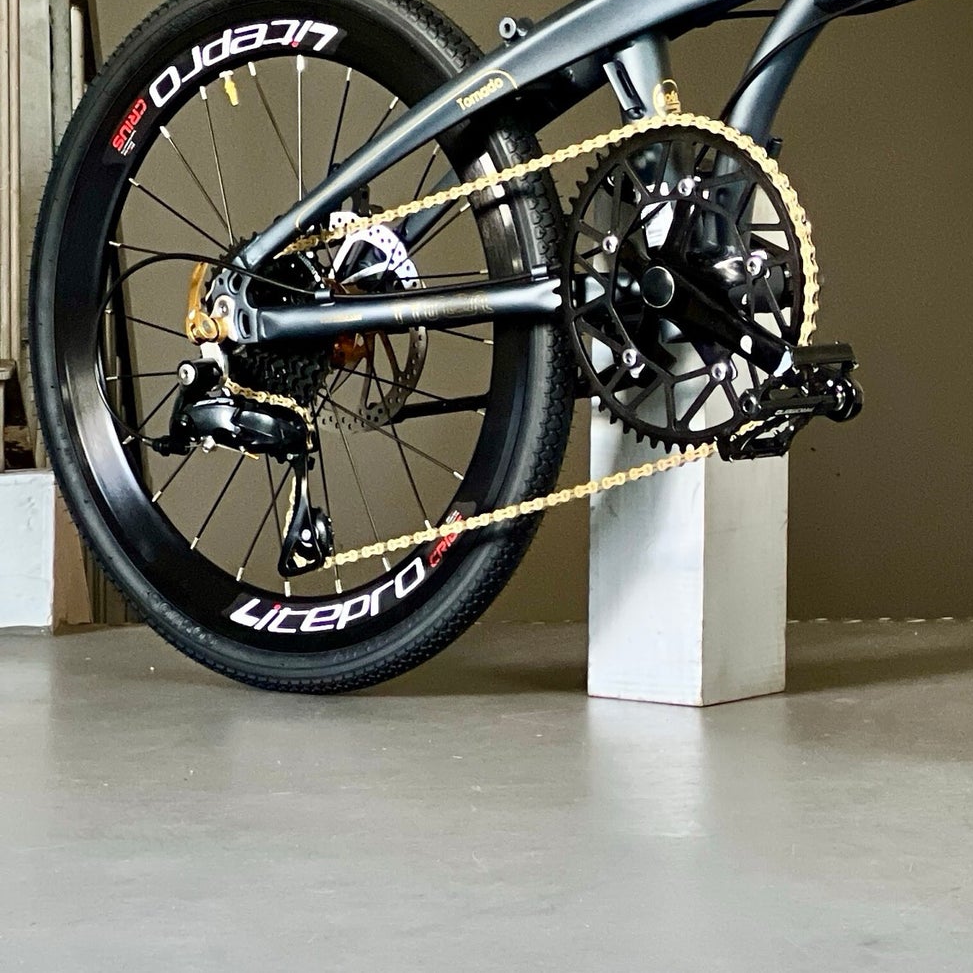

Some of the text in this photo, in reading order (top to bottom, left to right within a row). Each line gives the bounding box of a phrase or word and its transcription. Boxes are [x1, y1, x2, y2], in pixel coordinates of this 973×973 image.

[149, 19, 339, 108] Litepro
[111, 97, 149, 152] CRIUS
[229, 556, 426, 634] Litepro
